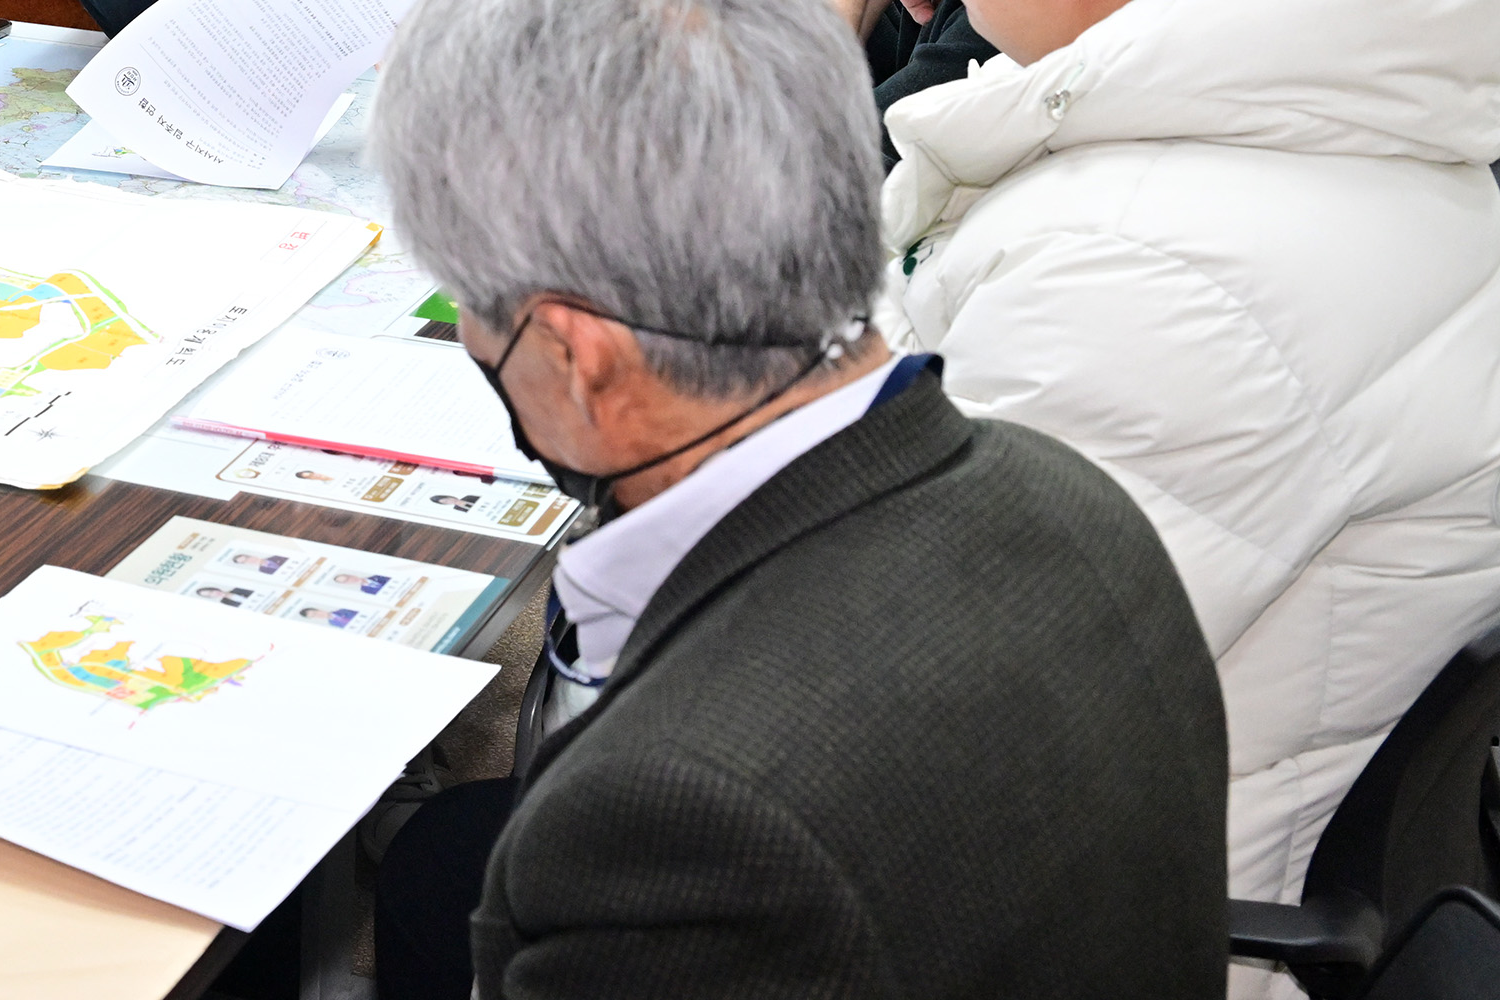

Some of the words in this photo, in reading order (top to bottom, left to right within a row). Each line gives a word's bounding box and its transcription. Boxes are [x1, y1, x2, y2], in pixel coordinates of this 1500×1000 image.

[138, 97, 156, 117] 연합
[157, 115, 184, 140] 입주자
[185, 140, 224, 164] 서사지구
